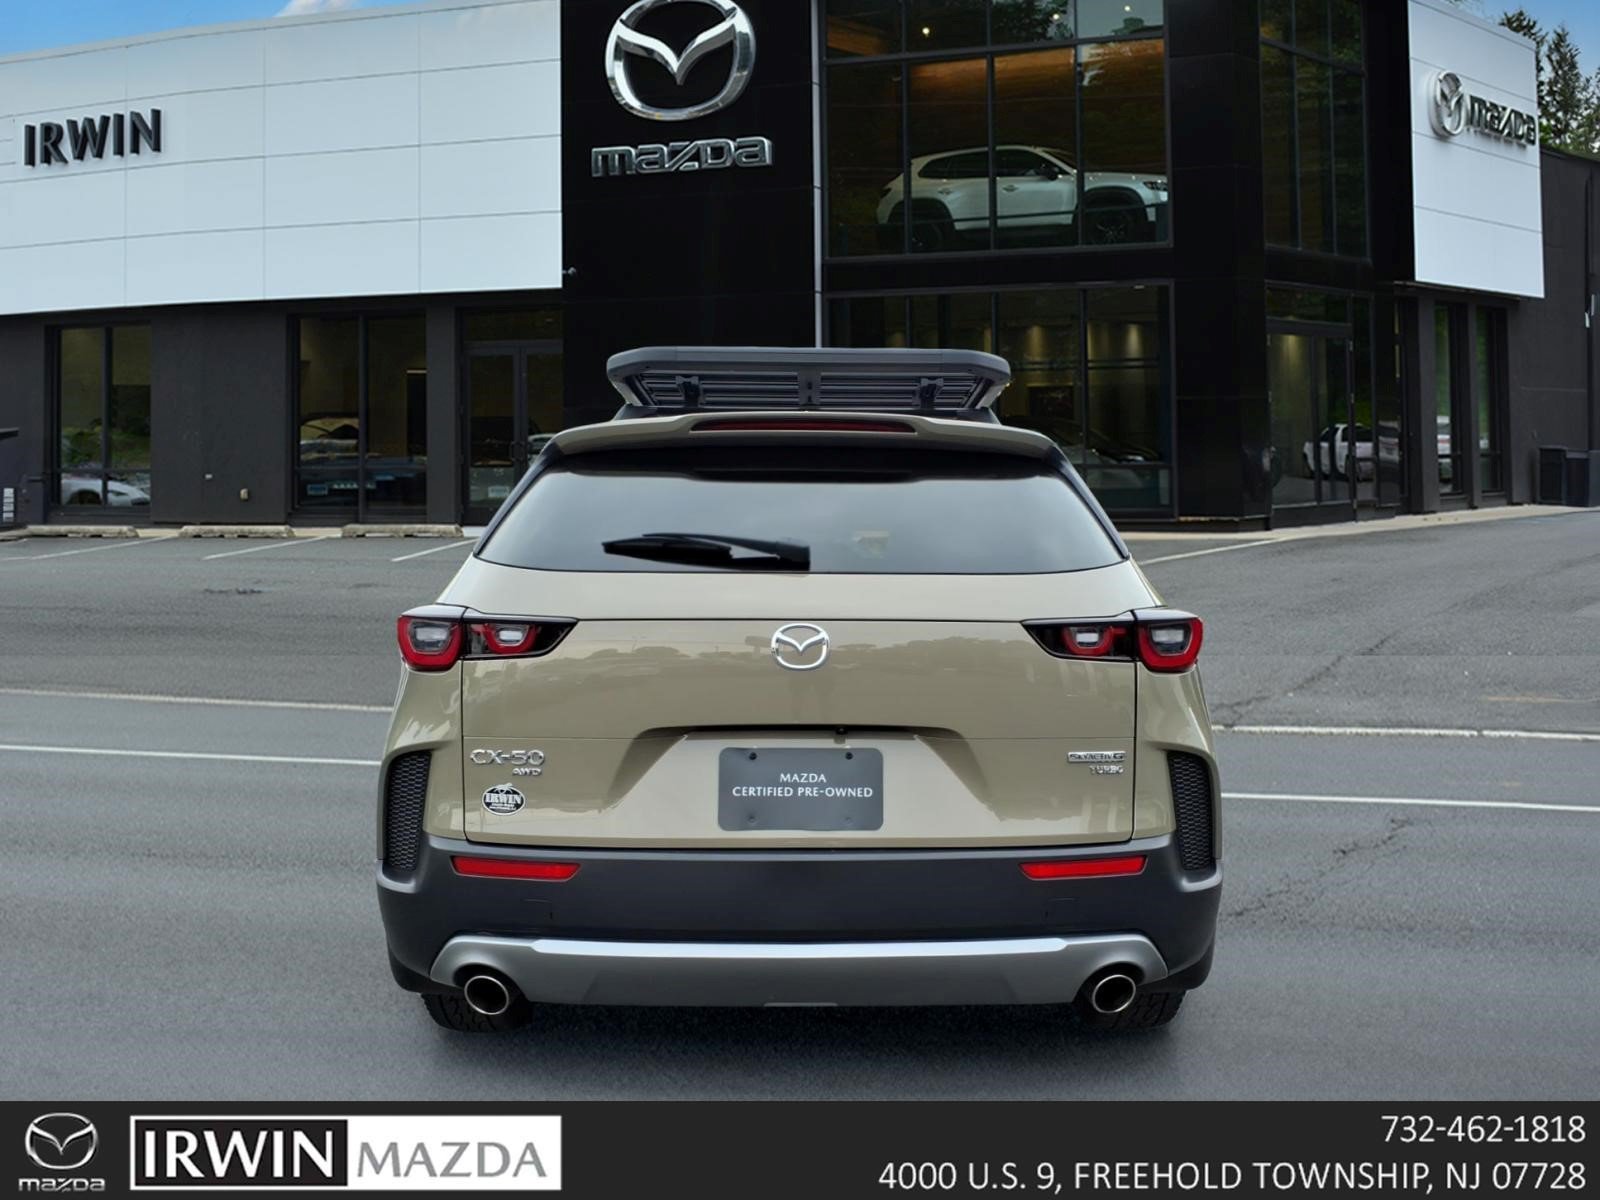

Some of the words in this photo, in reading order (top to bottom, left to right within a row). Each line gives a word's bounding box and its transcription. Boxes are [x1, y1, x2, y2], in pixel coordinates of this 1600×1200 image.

[24, 108, 162, 167] IRWIN
[470, 748, 545, 766] CX-50
[512, 767, 542, 776] AWD
[1089, 765, 1125, 775] TURBO
[779, 773, 827, 783] MAZDA
[732, 786, 793, 798] CERTIFIED
[798, 787, 873, 798] PRE-OWNED
